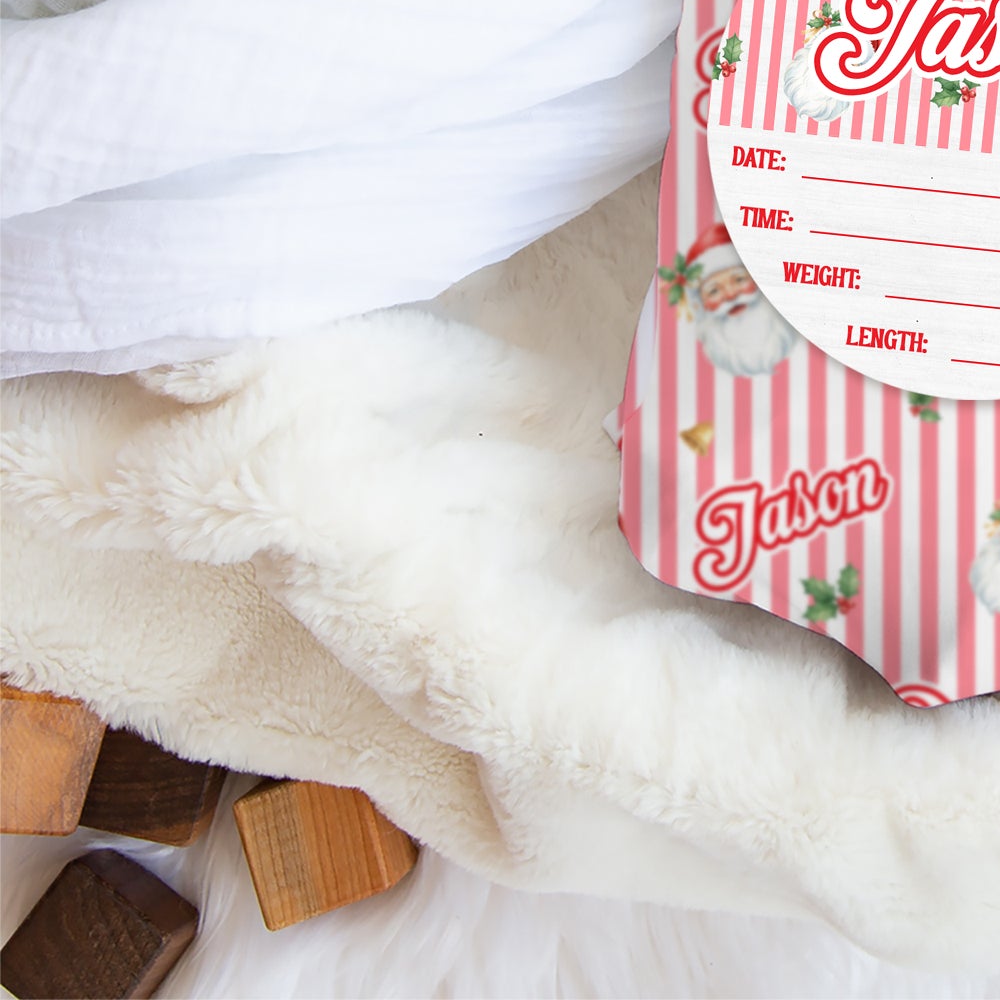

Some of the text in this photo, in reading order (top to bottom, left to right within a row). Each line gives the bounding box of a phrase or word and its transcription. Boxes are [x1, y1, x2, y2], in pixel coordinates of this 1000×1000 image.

[731, 145, 787, 172] DATE:
[739, 205, 795, 232] TIME:
[782, 261, 862, 290] WEIGHT:
[845, 324, 929, 354] LENGTH:
[693, 458, 889, 592] Jason
